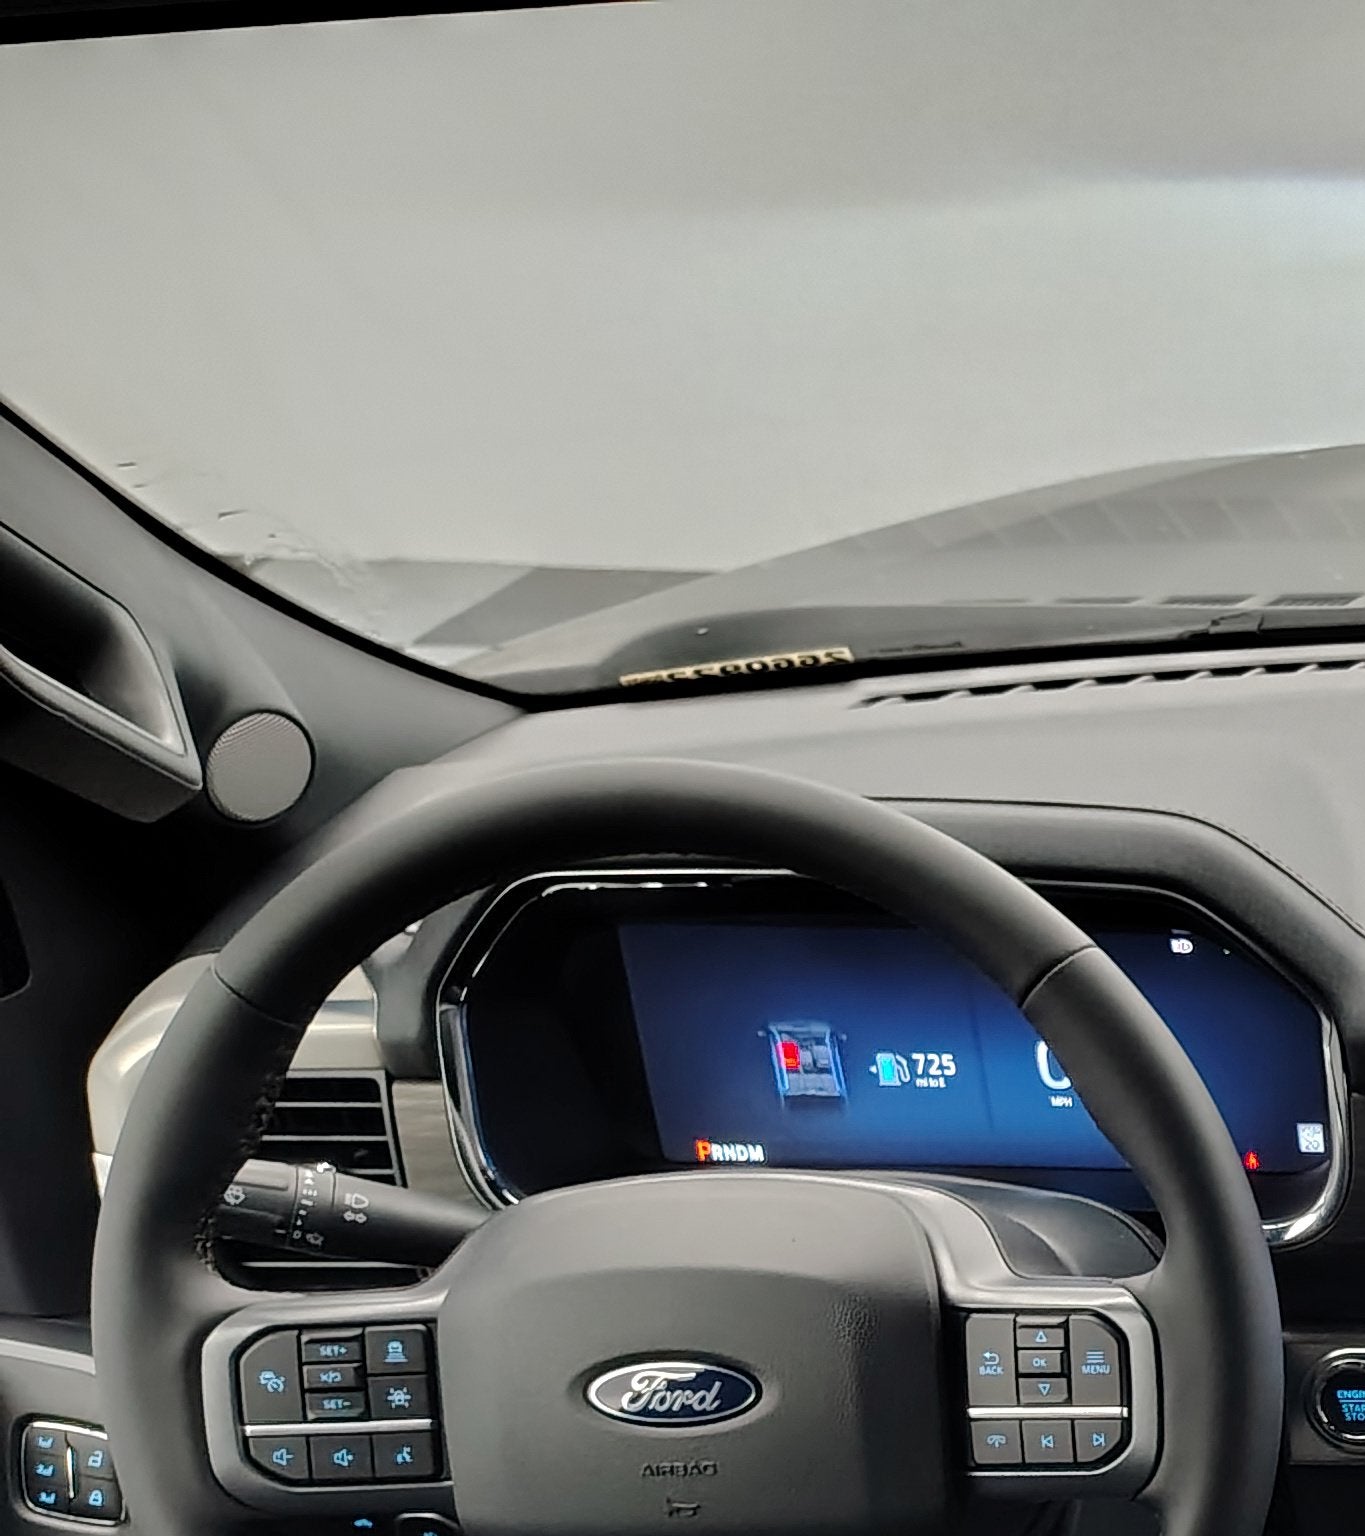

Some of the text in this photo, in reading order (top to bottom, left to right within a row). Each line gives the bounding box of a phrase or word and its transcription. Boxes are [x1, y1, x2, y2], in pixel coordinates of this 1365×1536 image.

[912, 1053, 956, 1076] 725
[1032, 1358, 1047, 1367] OK
[1081, 1364, 1111, 1375] MENU
[979, 1366, 1004, 1376] BACK
[621, 1369, 722, 1412] Ford
[641, 1461, 718, 1478] AIRBAG
